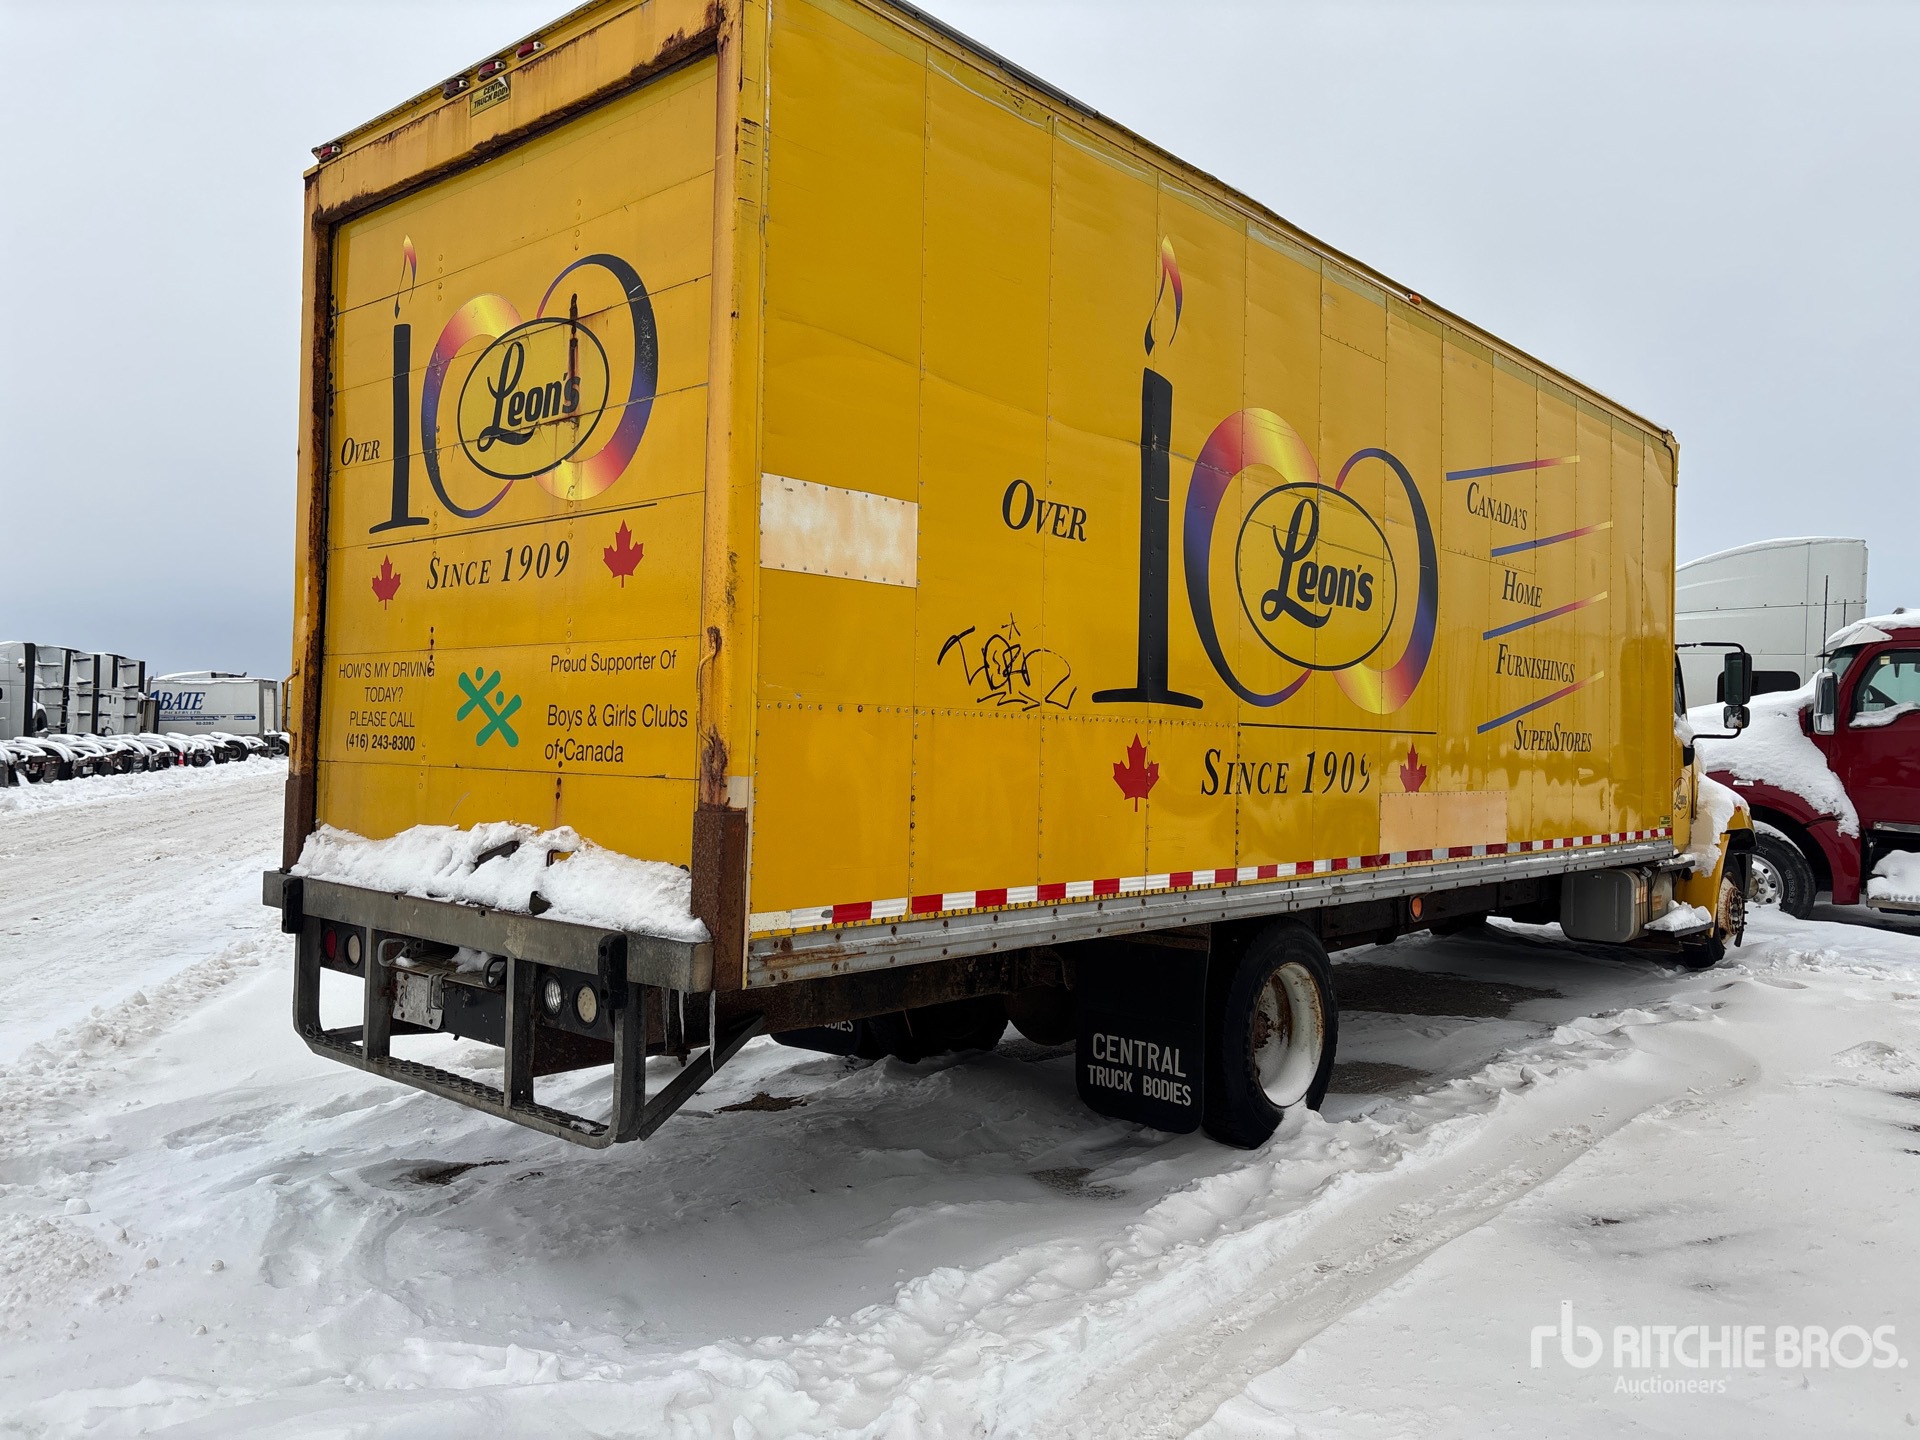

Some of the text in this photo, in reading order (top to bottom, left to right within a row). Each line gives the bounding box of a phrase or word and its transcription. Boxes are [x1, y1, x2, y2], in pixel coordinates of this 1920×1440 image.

[477, 341, 581, 453] Leon's
[1466, 481, 1528, 531] CANADA'S
[426, 540, 571, 590] SINCE 1909
[1260, 498, 1375, 628] Leon's
[1501, 569, 1543, 608] HOME
[338, 660, 435, 679] HOW'S MY DRIVING
[550, 649, 677, 676] Proud Supporter Of
[1495, 643, 1576, 684] FURNISHINGS
[364, 686, 404, 703] TODAY?
[349, 711, 416, 728] PLEASE CALL
[547, 703, 689, 732] Boys & Girls Clubs
[345, 732, 416, 752] (416) 243-8300
[544, 738, 624, 763] of Canada
[1200, 748, 1373, 796] SINCE 1909
[1092, 1031, 1187, 1079] CENTRAL
[1087, 1064, 1192, 1107] TRUCK BODIES
